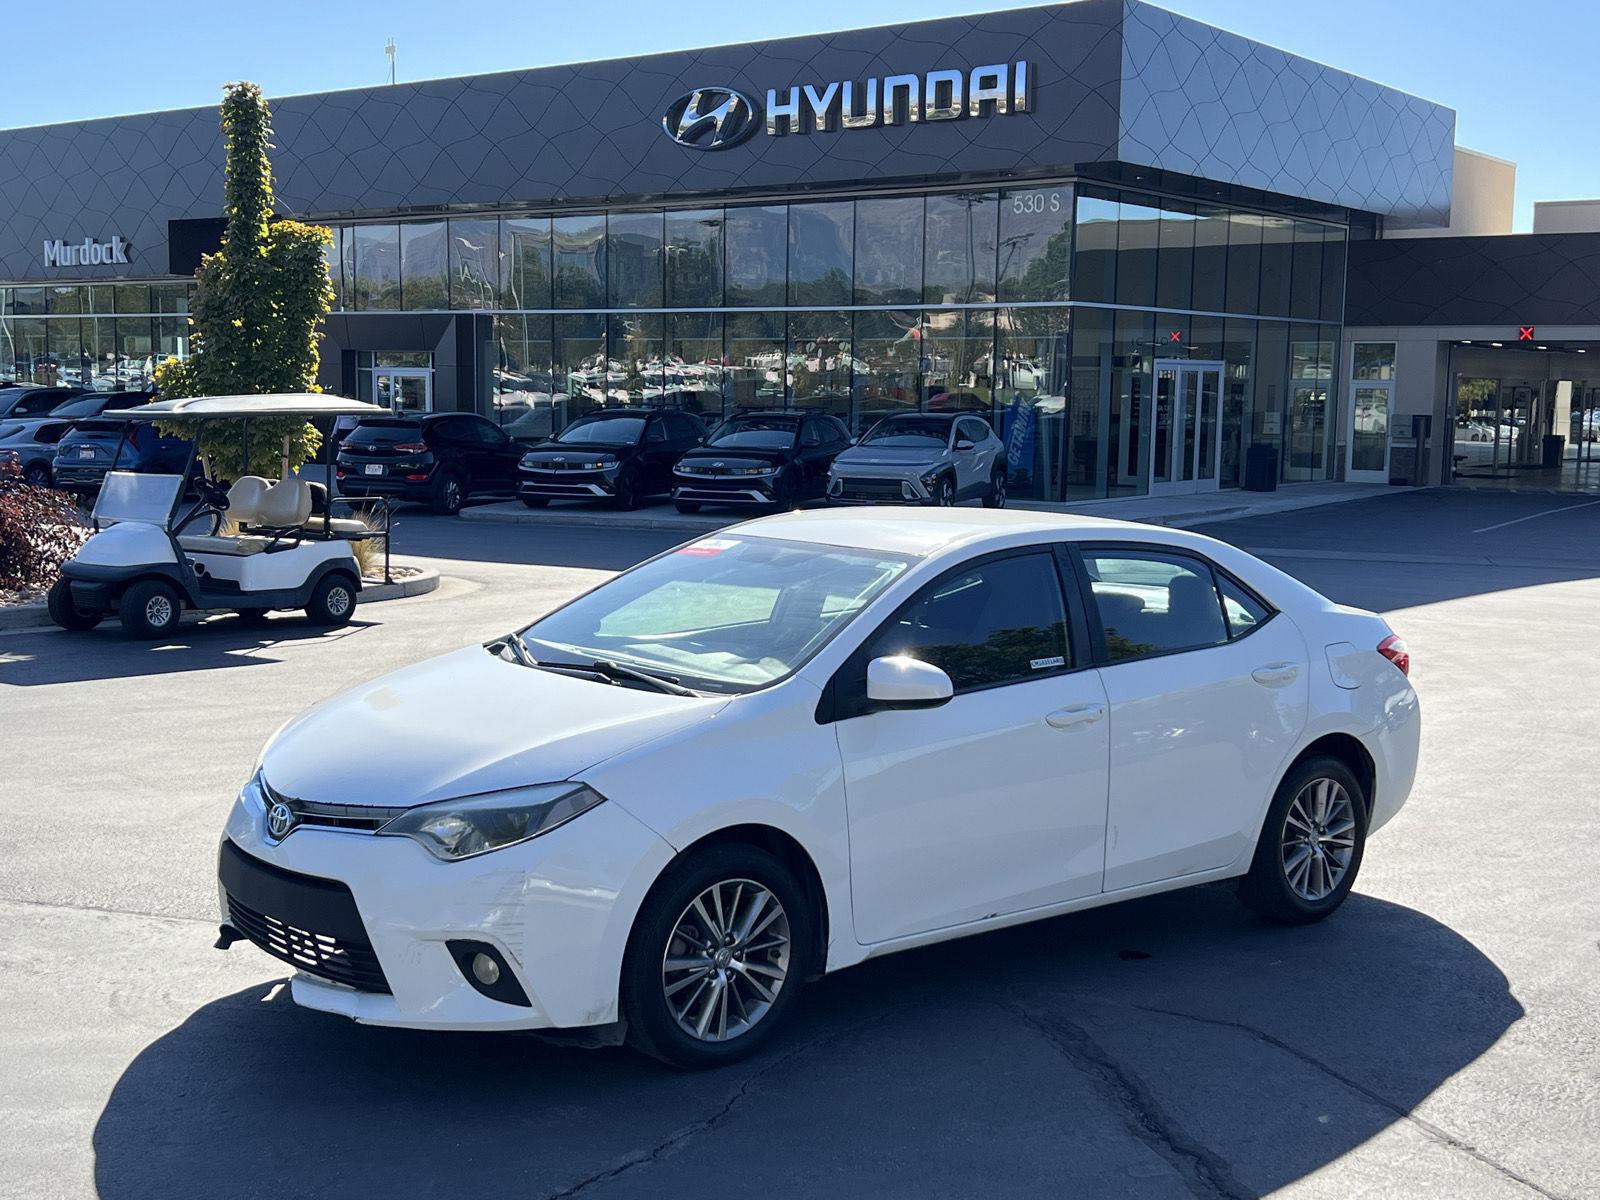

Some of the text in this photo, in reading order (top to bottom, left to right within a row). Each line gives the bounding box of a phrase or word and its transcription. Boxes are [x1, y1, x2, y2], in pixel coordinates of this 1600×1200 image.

[766, 60, 1030, 135] HYUNDAI
[1013, 192, 1060, 214] 530 S
[43, 236, 129, 267] Murdock
